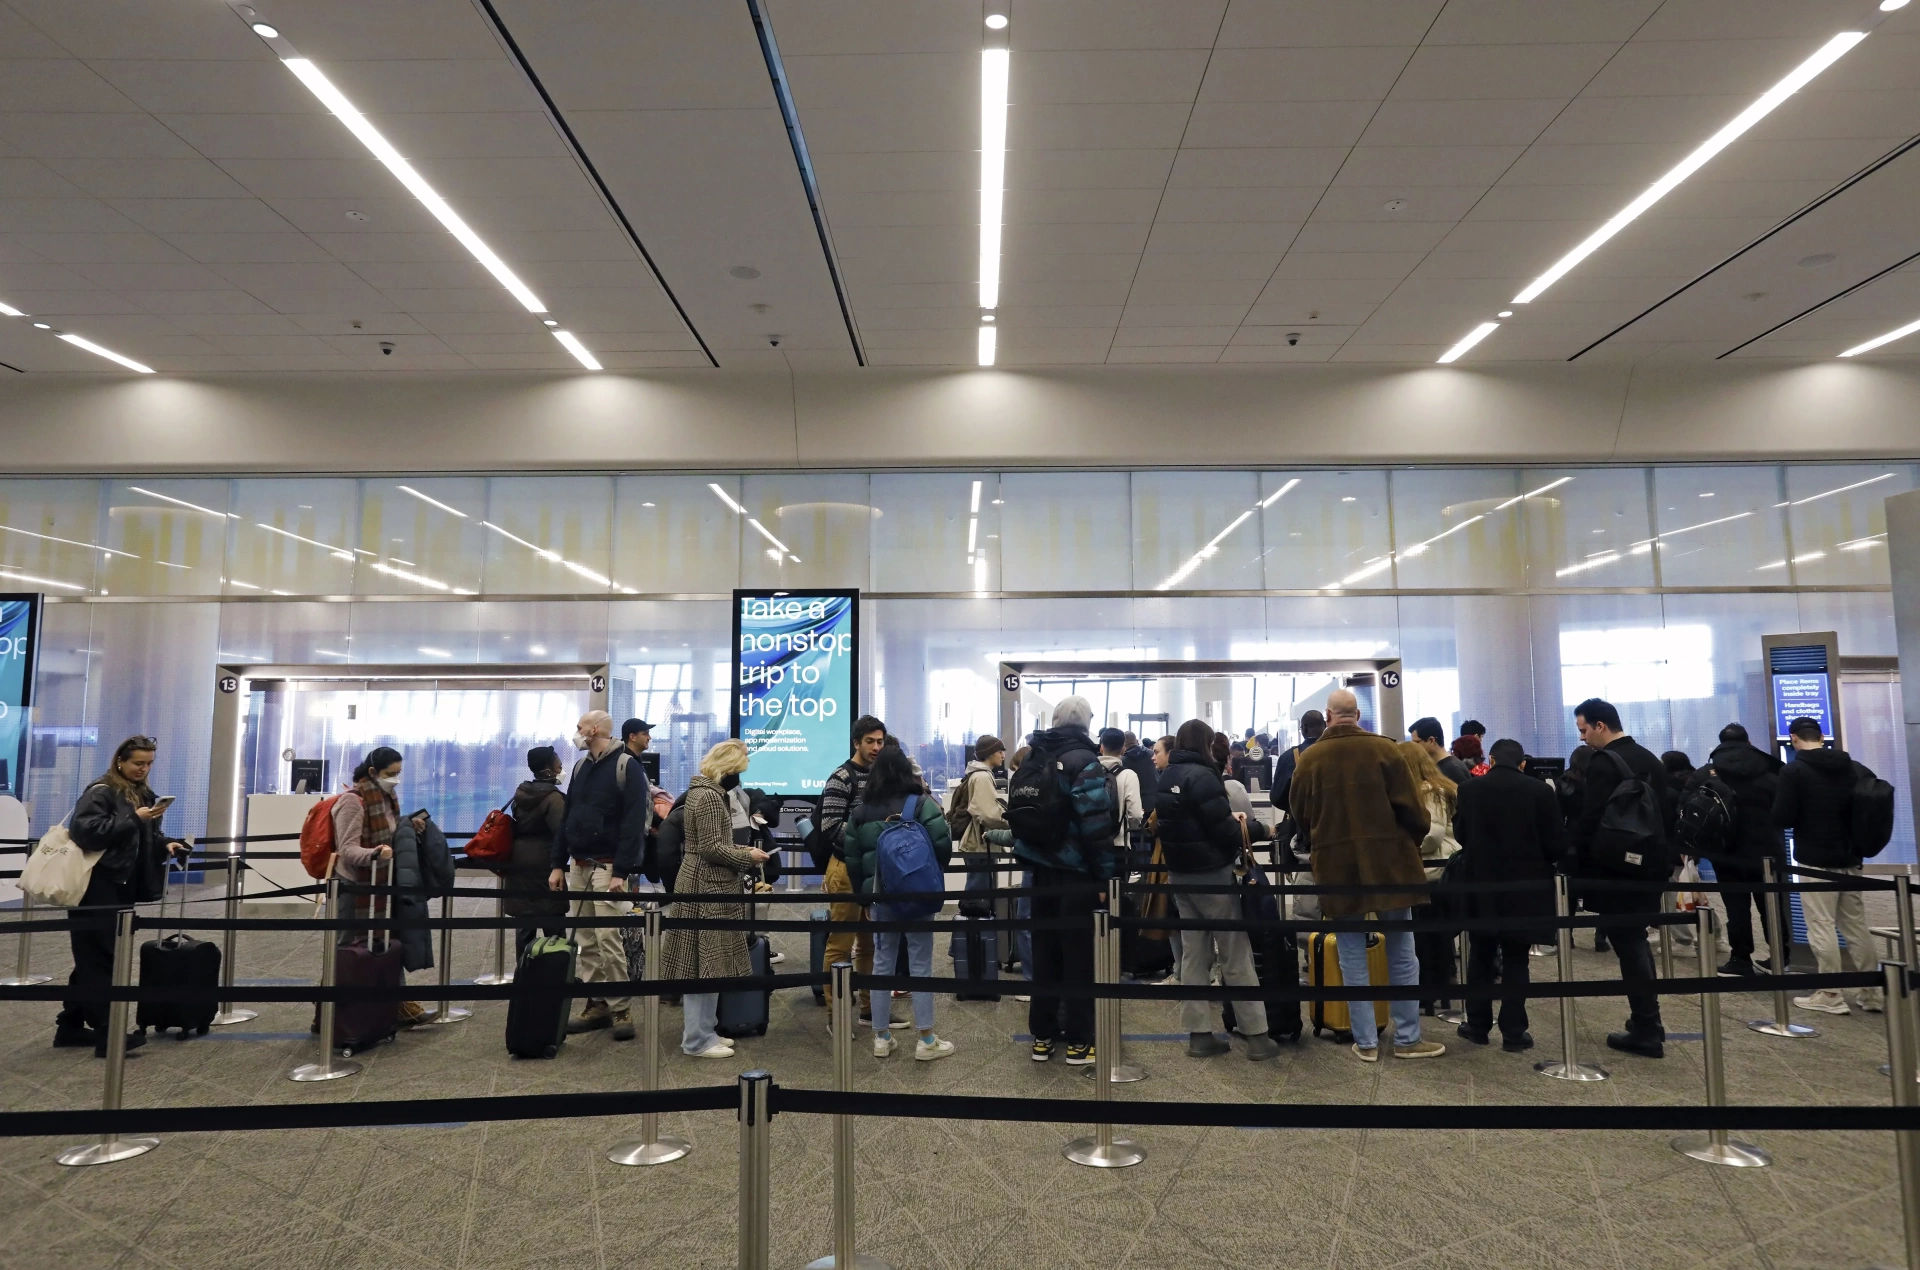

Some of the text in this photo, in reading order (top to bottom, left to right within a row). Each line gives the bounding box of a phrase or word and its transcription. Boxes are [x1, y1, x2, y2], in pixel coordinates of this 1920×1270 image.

[741, 597, 825, 619] Take a
[740, 629, 852, 656] nonstop
[740, 660, 820, 690] trip to
[1005, 677, 1018, 688] 15
[1383, 673, 1398, 685] 16
[221, 679, 237, 691] 13
[592, 678, 604, 690] 14
[739, 692, 837, 722] the top
